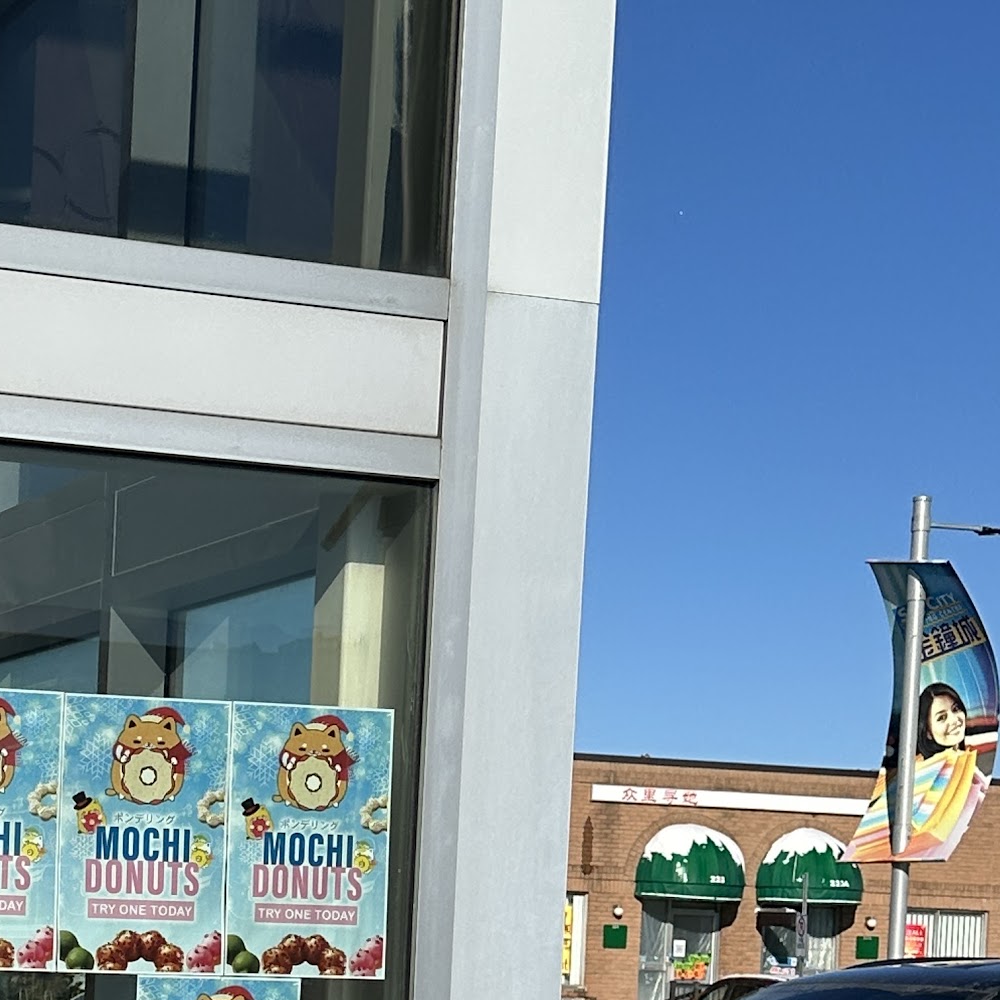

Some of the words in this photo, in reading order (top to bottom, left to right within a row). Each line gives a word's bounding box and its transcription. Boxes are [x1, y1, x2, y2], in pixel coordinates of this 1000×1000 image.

[926, 592, 956, 609] CITY
[114, 812, 176, 825] ポンデリング
[280, 818, 338, 830] ポンデリング
[95, 826, 190, 863] MOCHI
[263, 832, 354, 868] MOCHI
[84, 859, 200, 896] DONUTS
[252, 864, 362, 901] DONUTS
[92, 902, 116, 914] TRY
[119, 904, 147, 916] ONE
[151, 904, 192, 918] TODAY
[258, 907, 281, 920] TRY
[285, 908, 311, 920] ONE
[314, 909, 356, 922] TODAY
